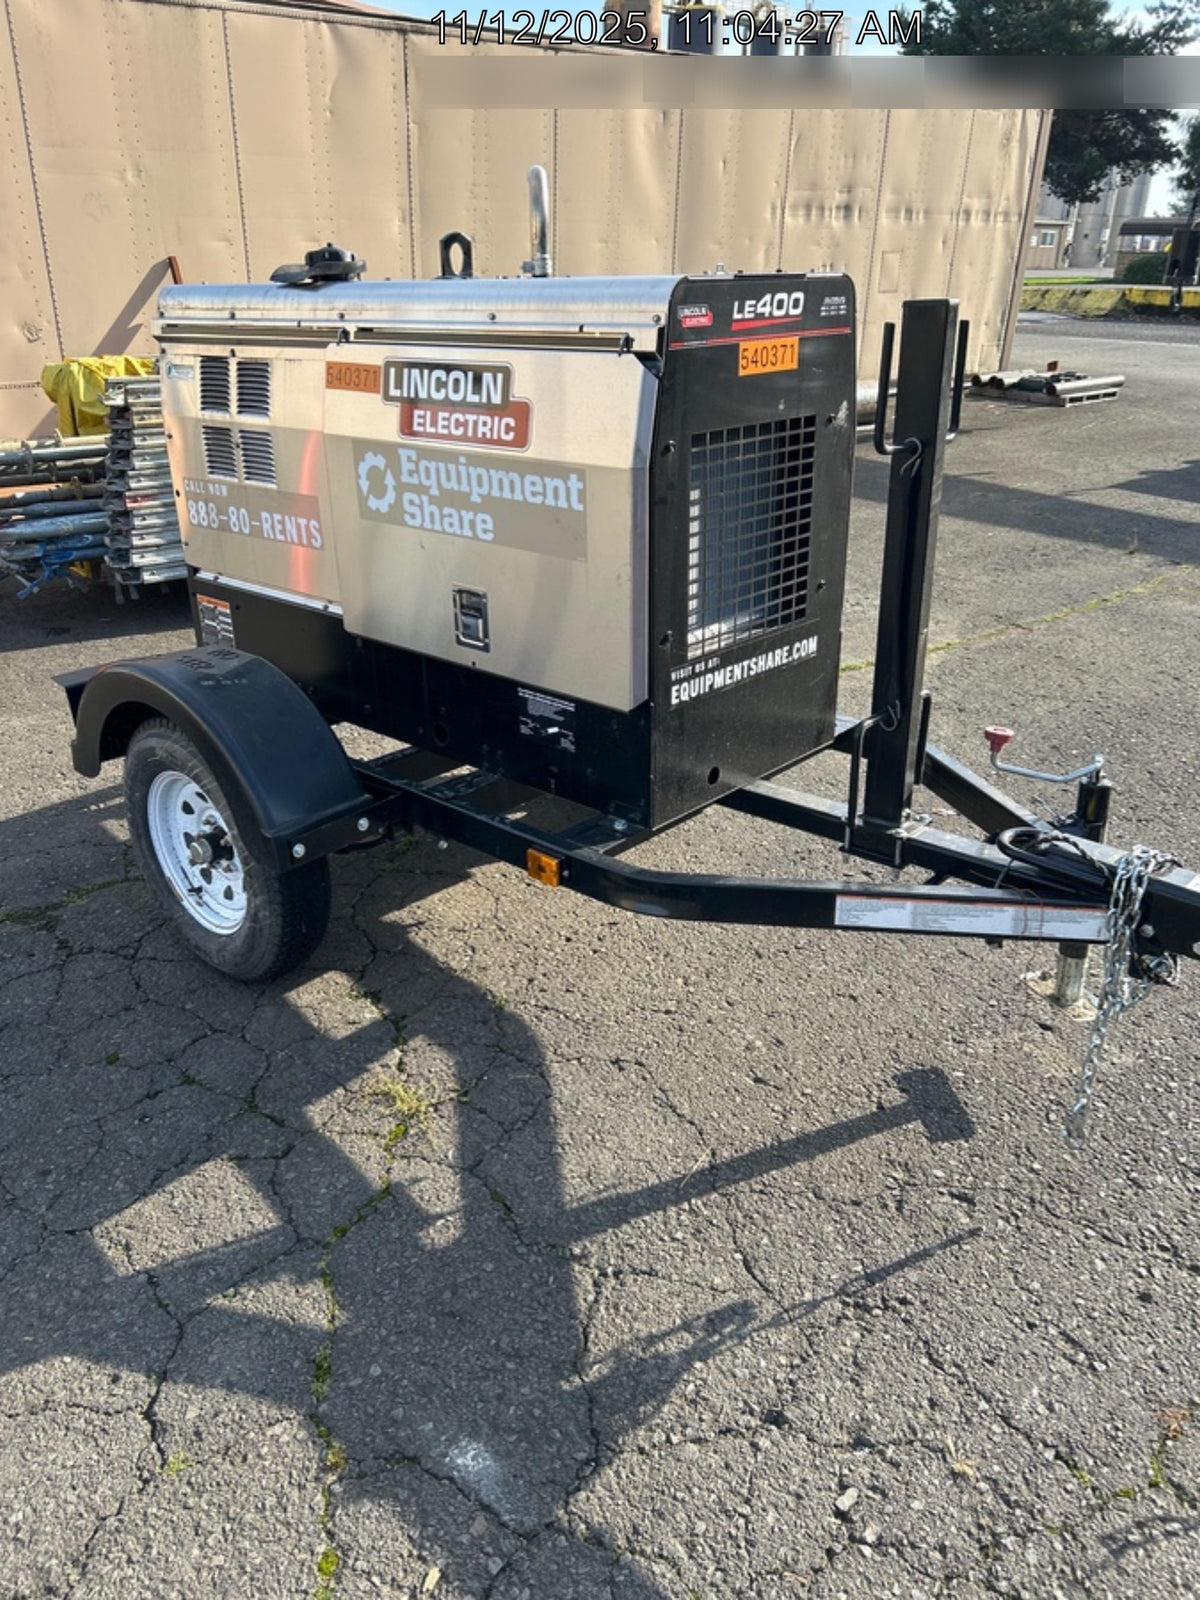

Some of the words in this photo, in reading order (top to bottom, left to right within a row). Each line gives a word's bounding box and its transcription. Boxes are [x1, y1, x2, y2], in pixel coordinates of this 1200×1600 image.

[732, 291, 805, 320] LE400
[740, 344, 796, 371] 540371
[326, 363, 380, 388] 540371
[387, 366, 504, 404] LINCOLN
[412, 409, 516, 441] ELECTRIC
[184, 479, 205, 493] CALL
[397, 447, 584, 511] Equipment
[188, 499, 323, 548] 888-80-RENTS
[403, 491, 495, 541] Share
[670, 635, 819, 705] EQUIPMENTSHARE.COM
[671, 667, 692, 681] VISIT
[694, 661, 705, 673] US
